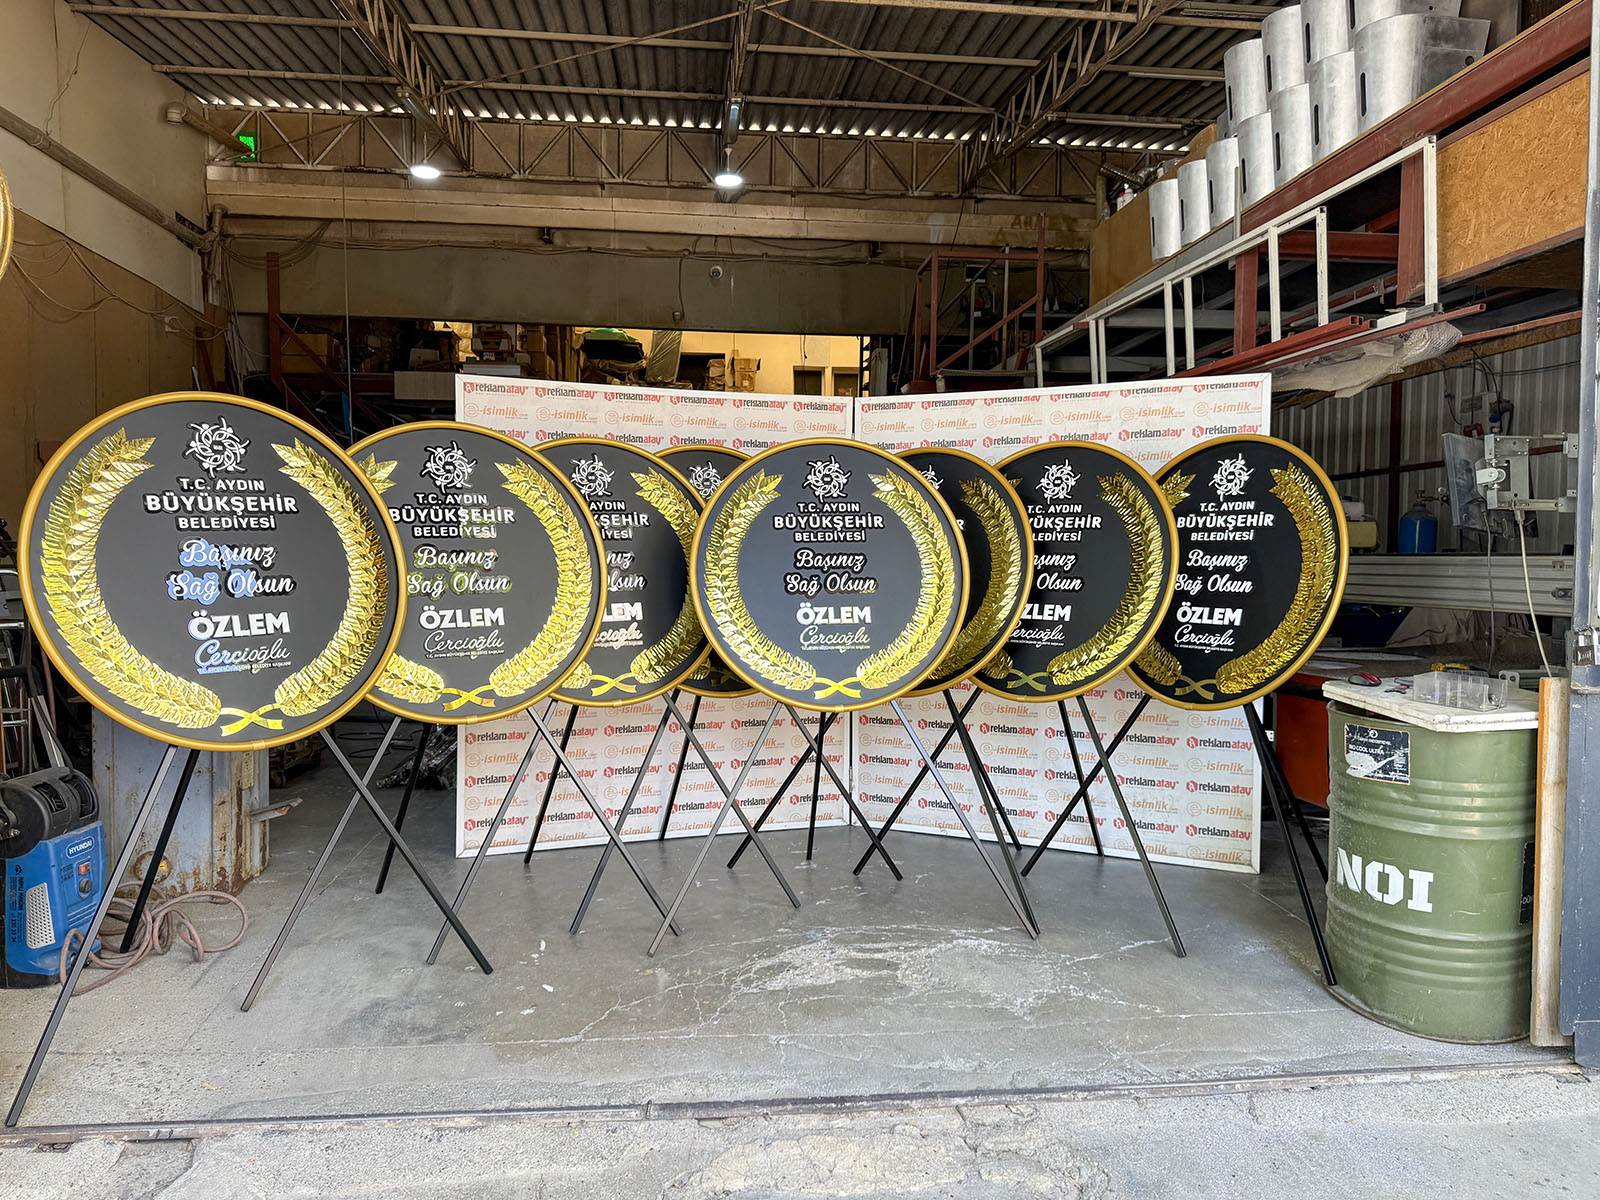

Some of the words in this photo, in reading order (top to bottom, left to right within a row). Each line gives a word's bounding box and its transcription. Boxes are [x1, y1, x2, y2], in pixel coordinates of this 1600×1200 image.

[180, 478, 209, 491] T.C.
[217, 478, 265, 491] AYDIN
[145, 494, 298, 514] BÜYÜKŞEHİR
[416, 494, 442, 504] T.C.
[445, 494, 487, 504] AYDIN
[589, 501, 625, 510] AYDIN
[797, 503, 820, 512] T.C.
[823, 503, 859, 512] AYDIN
[1028, 505, 1045, 513] T.C.
[1049, 504, 1082, 513] AYDIN
[1199, 503, 1218, 512] T.C.
[1220, 501, 1254, 511] AYDIN
[178, 515, 276, 529] BELEDİYESİ
[391, 507, 515, 525] BÜYÜKŞEHİR
[773, 512, 884, 530] BÜYÜKŞEHİR
[1177, 513, 1274, 529] BÜYÜKŞEHİR
[414, 525, 496, 537] BELEDİYESİ
[795, 531, 866, 542] BELEDİYESİ
[1032, 531, 1081, 542] LEDİYESİ
[1191, 529, 1253, 541] BELEDİYESİ
[182, 540, 276, 568] Başınız
[417, 546, 496, 570] Başınız
[796, 550, 865, 571] Başınız
[1187, 549, 1248, 570] Başınız
[170, 572, 218, 602] Sağ
[226, 570, 294, 596] Olsun
[407, 575, 446, 598] Sağ
[452, 572, 511, 593] Olsun
[786, 576, 820, 596] Sağ
[826, 574, 876, 592] Olsun
[1037, 572, 1082, 591] Olsun
[1175, 573, 1202, 592] Sağ
[1207, 574, 1252, 593] Olsun
[420, 605, 505, 628] ÖZLEM
[603, 602, 643, 622] LEM
[796, 602, 871, 625] ÖZLEM
[1020, 603, 1072, 622] ZLEM
[1177, 602, 1243, 626] ÖZLEM
[188, 609, 290, 639] ÖZLEM
[69, 840, 93, 855] HYUNDAI
[1337, 846, 1434, 913] NOI
